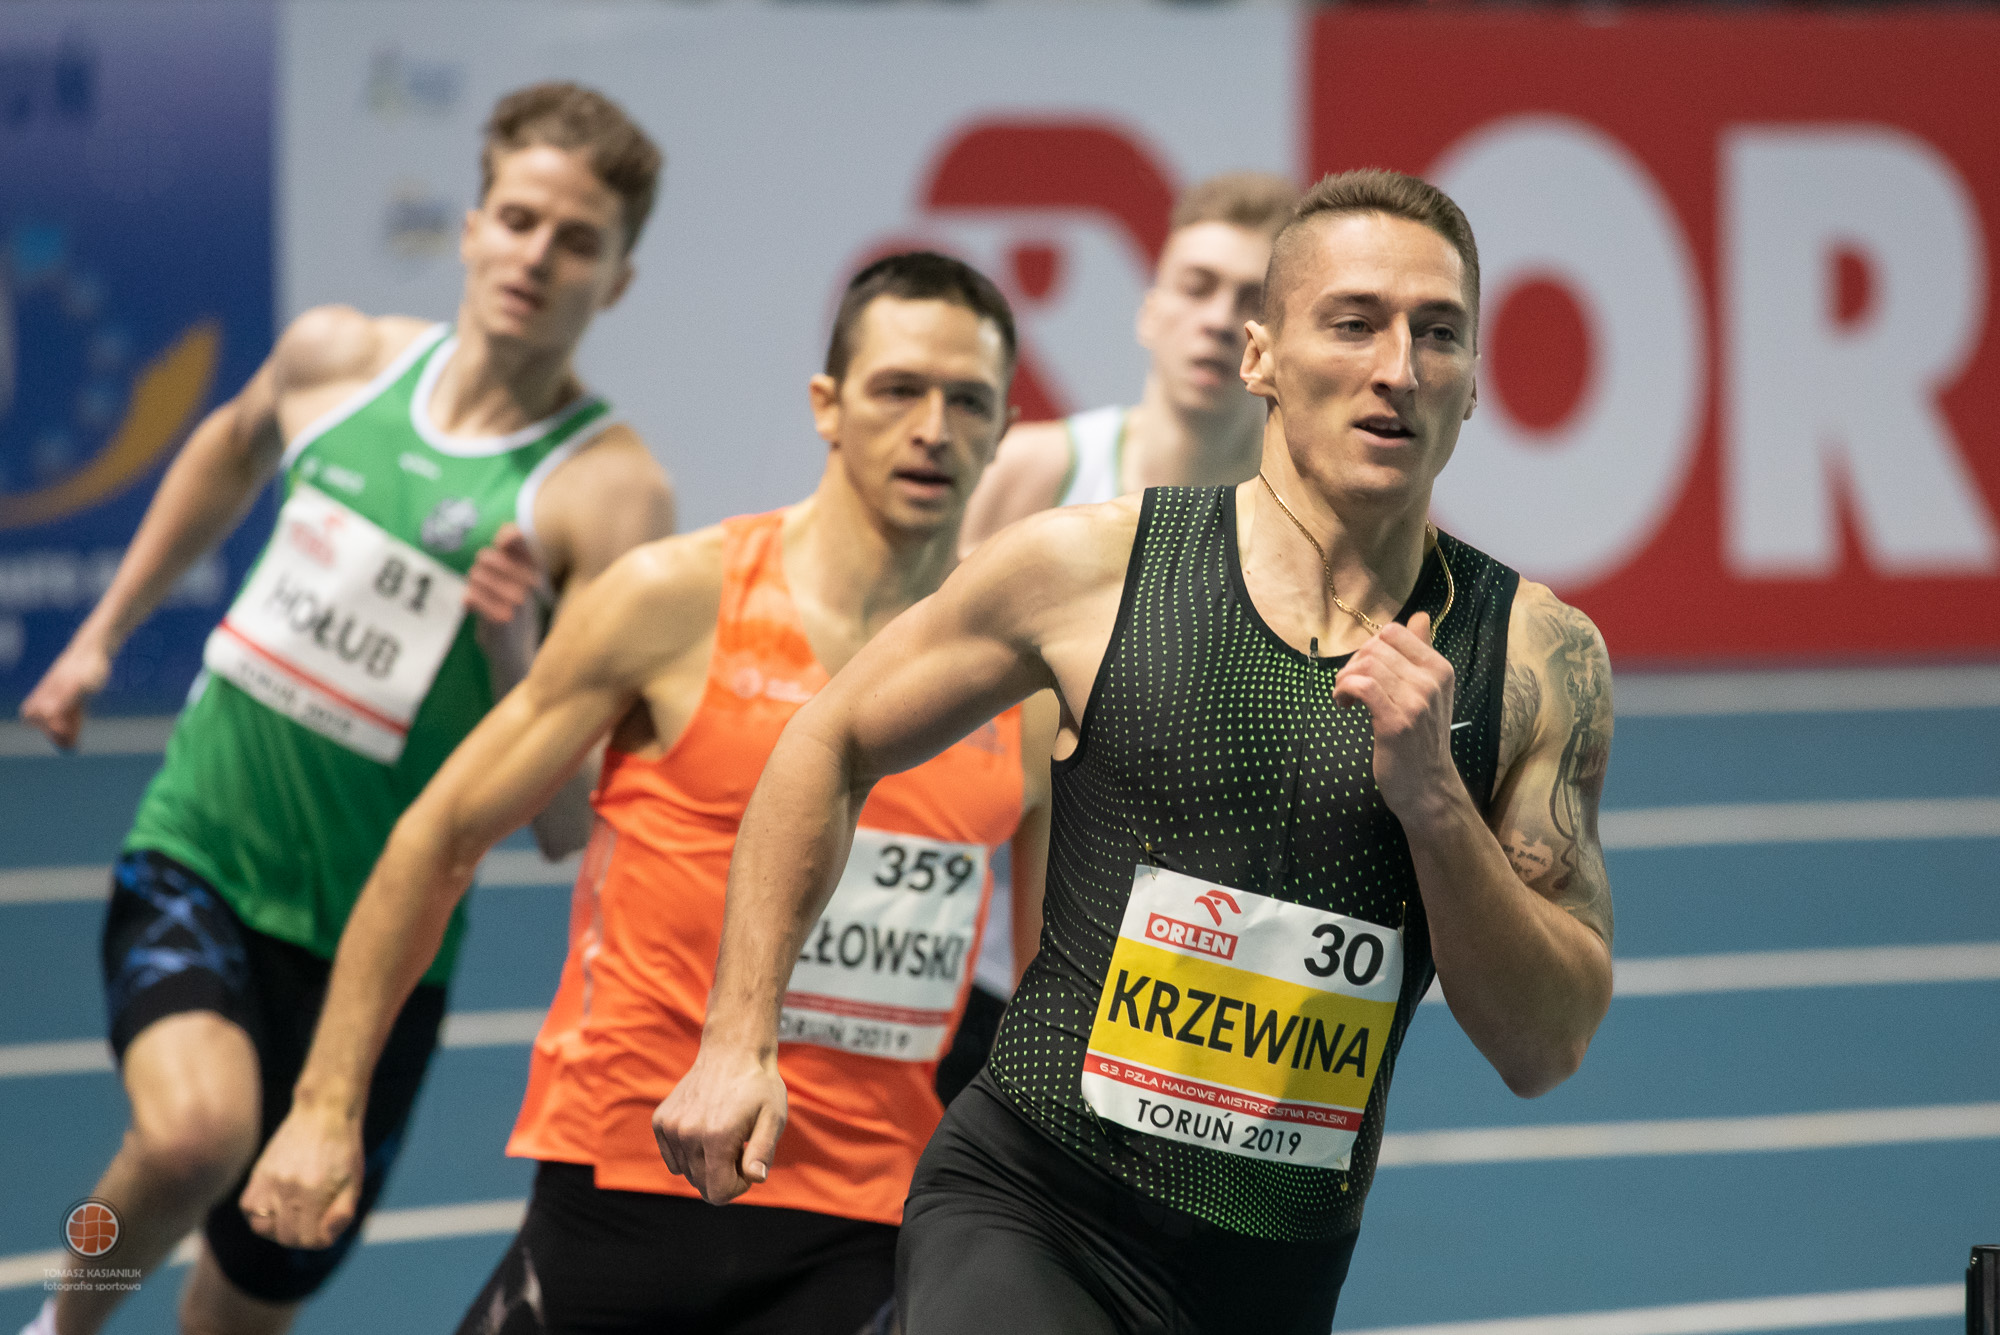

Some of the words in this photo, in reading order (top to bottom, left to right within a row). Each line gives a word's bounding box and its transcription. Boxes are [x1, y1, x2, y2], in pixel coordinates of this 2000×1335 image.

[374, 555, 432, 615] 81
[260, 572, 402, 680] HOŁUB
[874, 845, 974, 896] 359
[799, 918, 965, 981] ŁOWSKI
[1151, 921, 1232, 957] ORLEN
[1304, 922, 1384, 986] 30
[1107, 969, 1370, 1078] KRZEWINA
[1099, 1062, 1121, 1077] 63.
[1124, 1069, 1158, 1087] PZLA
[1161, 1080, 1216, 1101] HALOWE
[1218, 1093, 1304, 1119] MISTRZOSTWA
[1306, 1110, 1348, 1126] POLSKI
[1137, 1098, 1234, 1144] TORUŃ
[1240, 1125, 1302, 1156] 2019
